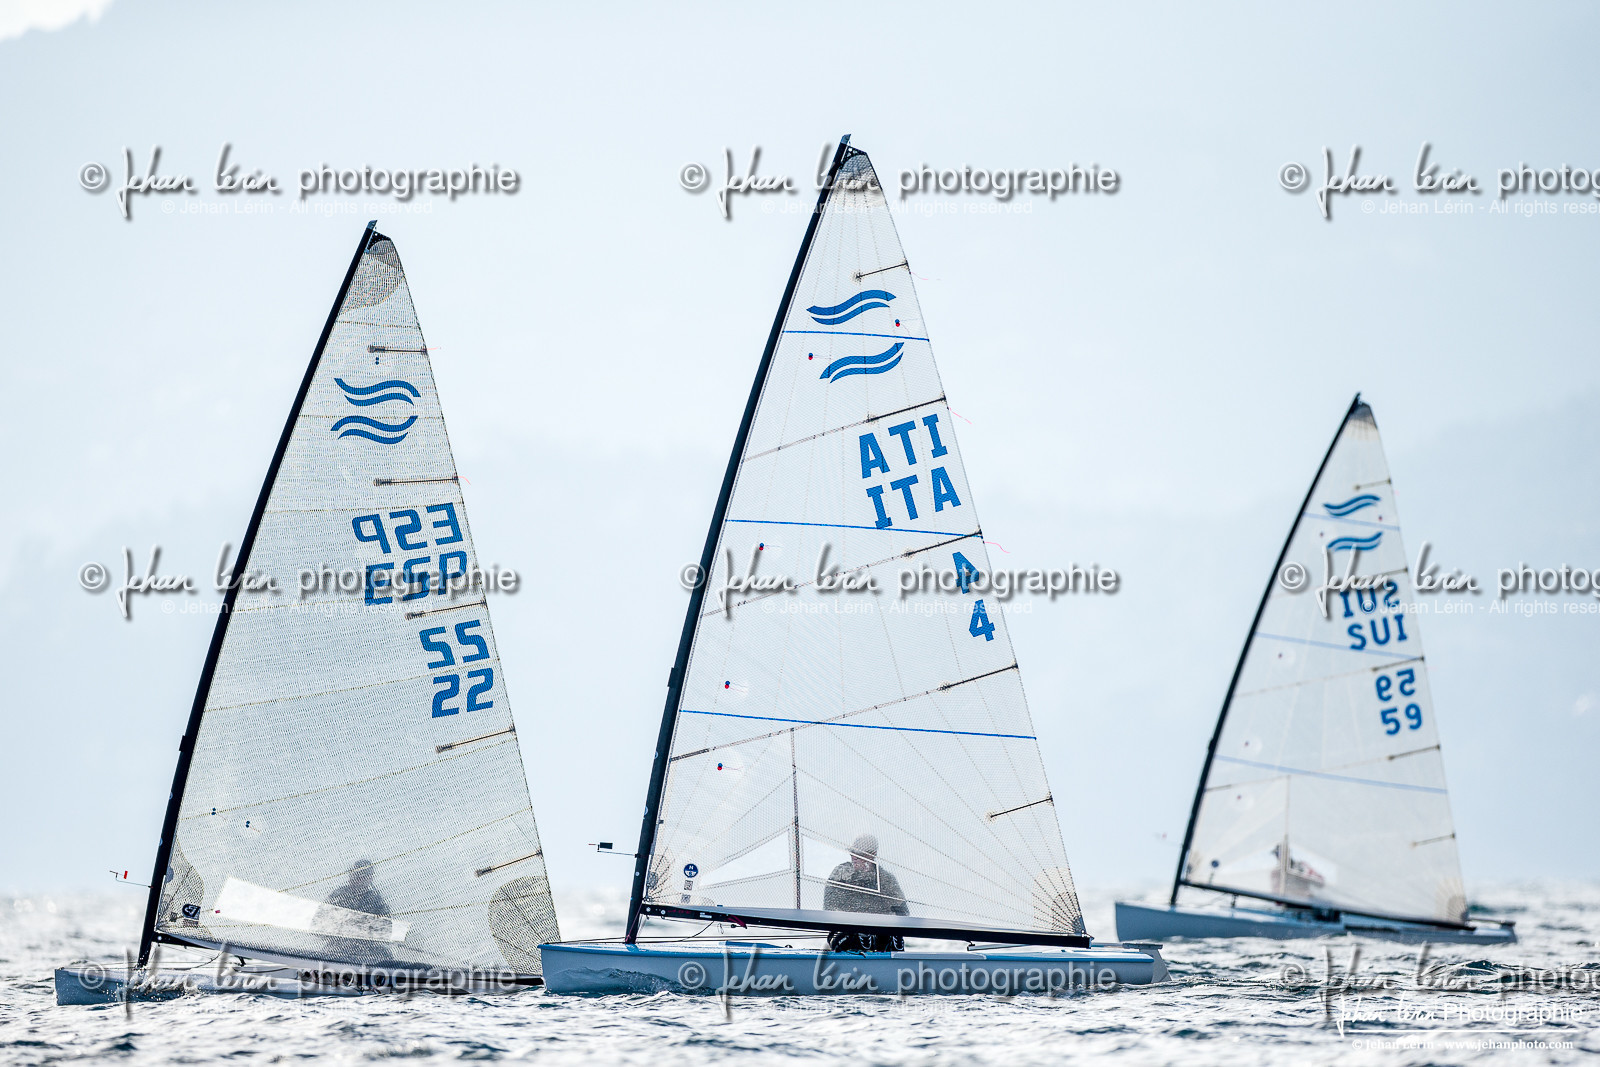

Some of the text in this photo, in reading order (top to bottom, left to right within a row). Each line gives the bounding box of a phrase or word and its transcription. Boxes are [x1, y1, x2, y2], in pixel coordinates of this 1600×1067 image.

[867, 467, 961, 529] ITA
[364, 550, 468, 606] ESP
[969, 600, 995, 641] 4
[1347, 614, 1408, 651] SUI
[432, 668, 494, 718] 22
[1380, 703, 1423, 735] 59
